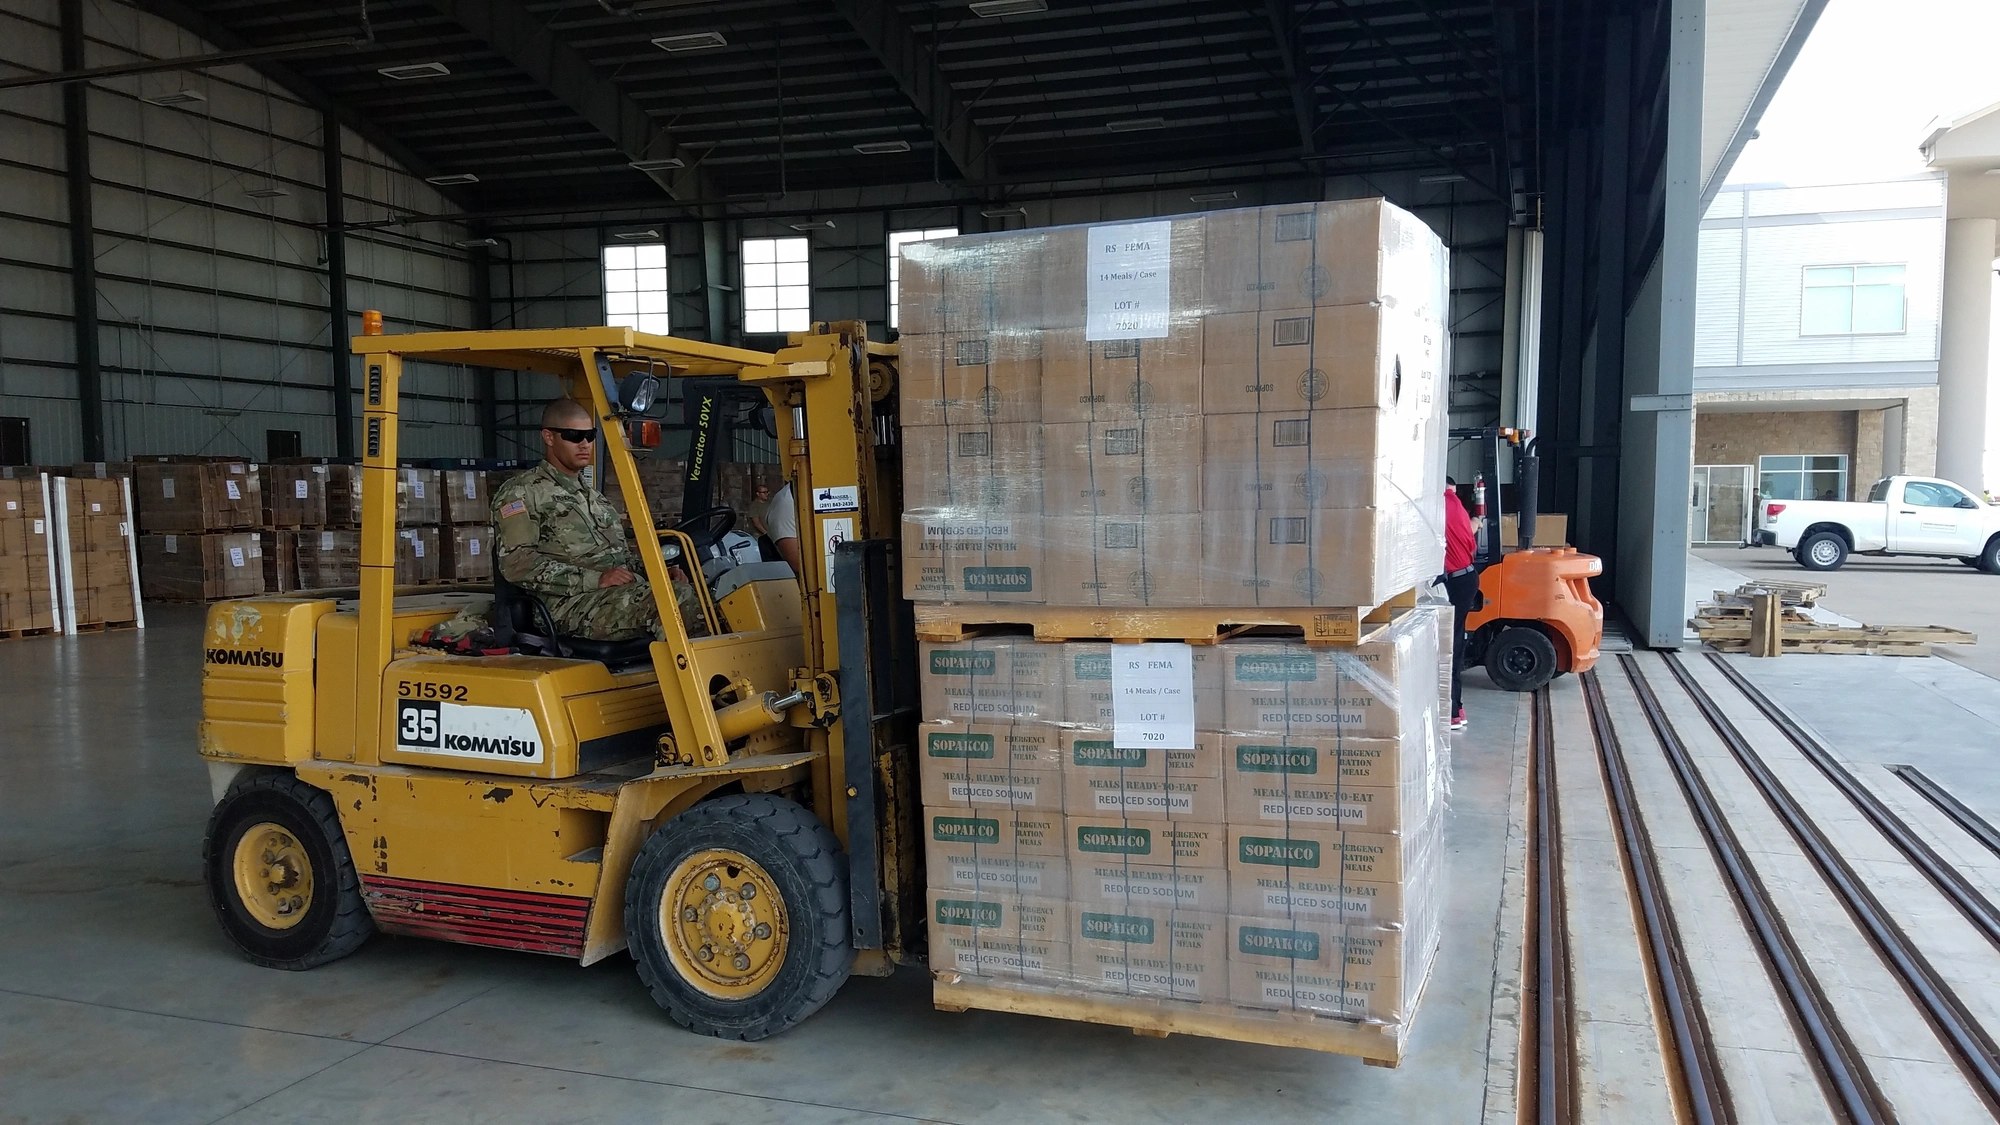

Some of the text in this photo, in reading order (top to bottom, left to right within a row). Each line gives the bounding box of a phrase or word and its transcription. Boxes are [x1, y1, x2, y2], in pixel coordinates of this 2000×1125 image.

[1105, 242, 1151, 253] RS FEMA
[1111, 272, 1132, 281] Meals
[1114, 301, 1140, 310] LOT #
[1116, 322, 1138, 331] 7020
[690, 395, 713, 481] Veracitor 50VX
[205, 646, 284, 668] KOMATSU
[1129, 661, 1173, 669] RS FEMA
[398, 680, 469, 701] 51592
[1135, 687, 1157, 695] Meals
[1163, 687, 1181, 695] Case
[953, 702, 1036, 713] REDUCED SODIUM
[1140, 713, 1158, 721] LOT
[1262, 713, 1362, 723] REDUCED SODIUM
[401, 708, 438, 745] 35
[1142, 733, 1165, 741] 7020
[444, 733, 536, 757] KOMATSU
[933, 740, 989, 752] SOPAKCO
[1012, 744, 1039, 752] RATION
[1080, 748, 1141, 760] SOPAKCO
[1242, 753, 1311, 767] SOPAKCO
[1168, 761, 1195, 769] MEALS
[1341, 768, 1370, 777] MEALS
[952, 787, 1033, 800] REDUCED SODIUM
[1098, 795, 1189, 808] REDUCED SODIUM
[1263, 804, 1363, 819] REDUCED SODIUM
[1083, 833, 1145, 847] SOPAKCO
[1245, 844, 1314, 860] SOPAKCO
[1343, 853, 1375, 863] RATION
[1344, 863, 1373, 872] MEALS
[1104, 884, 1150, 895] REDUCED
[1267, 896, 1367, 912] REDUCED SODIUM
[940, 907, 997, 920] SOPAKCO
[1086, 920, 1149, 936] SOPAKCO
[1176, 940, 1202, 949] MEALS
[1245, 934, 1313, 952] SOPAKCO
[1346, 947, 1374, 956] ATION
[958, 953, 1041, 969] REDUCED SODIUM
[1105, 971, 1196, 988] REDUCED SODIUM
[1266, 988, 1365, 1008] REDUCED SODIUM
